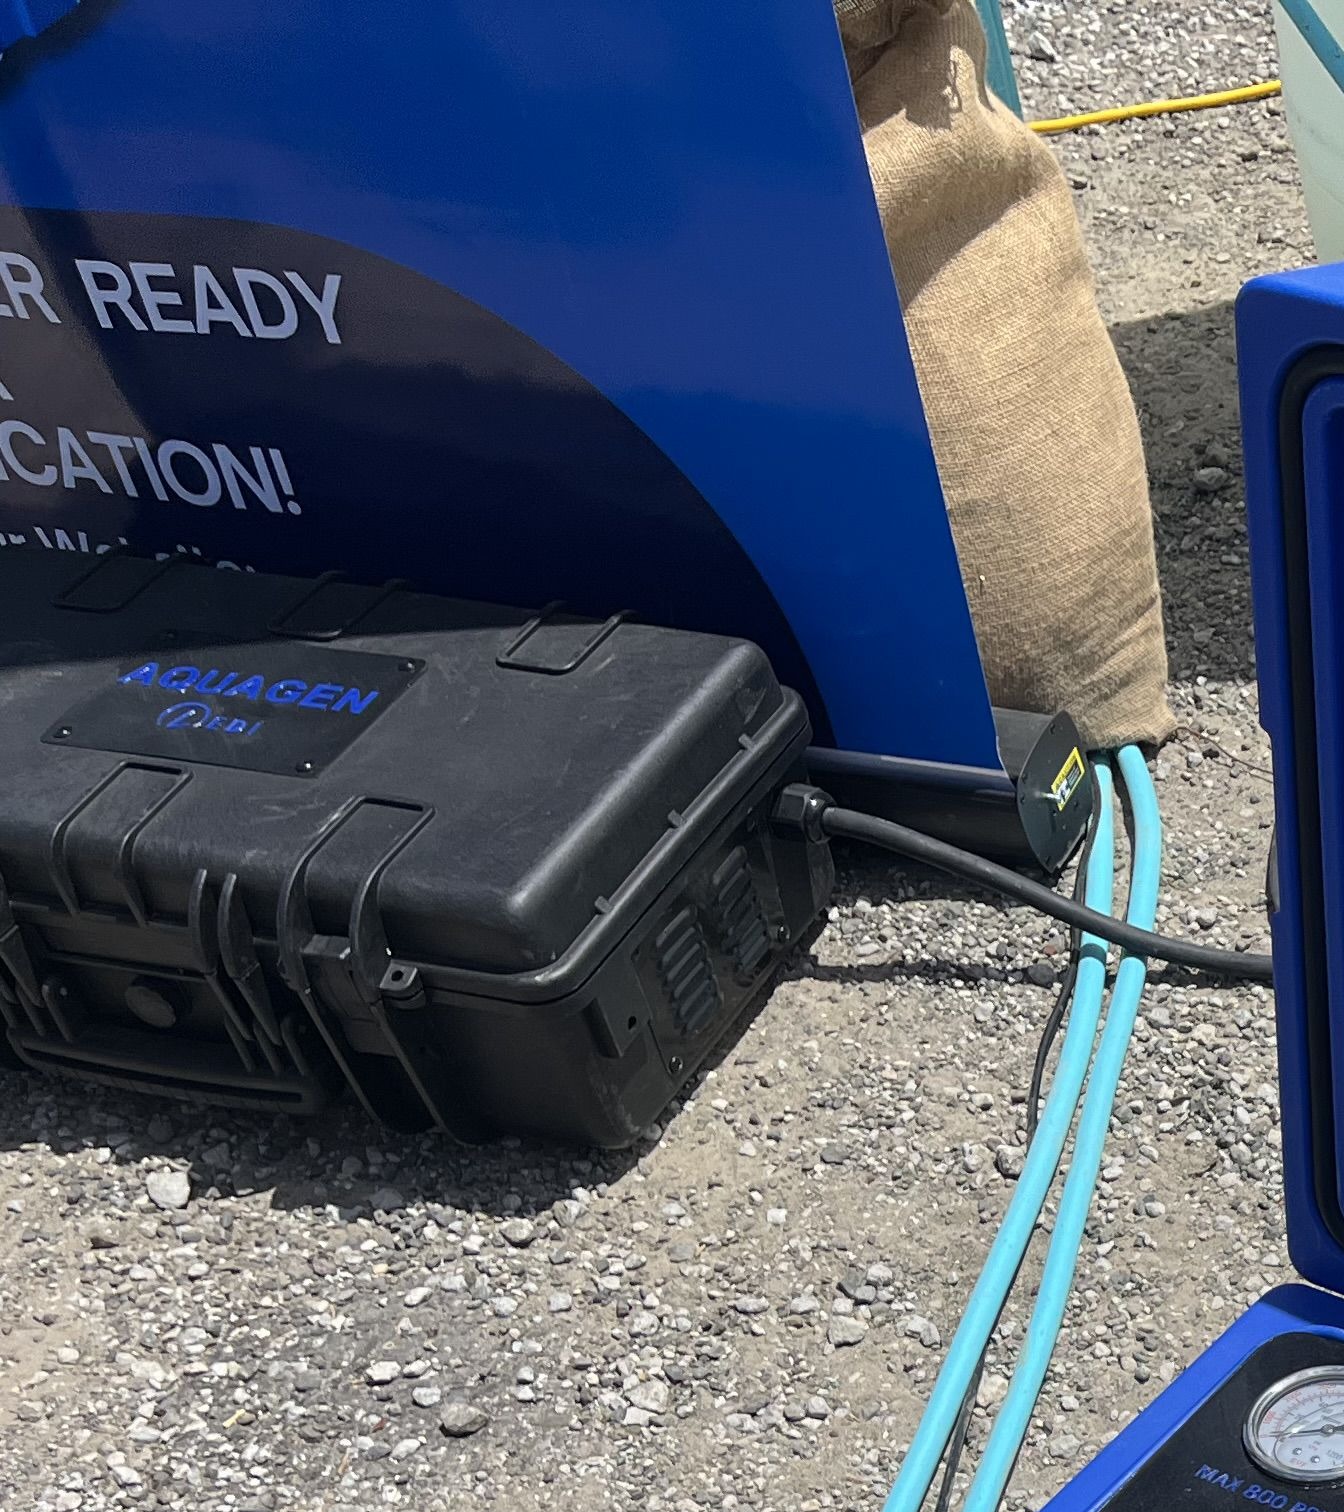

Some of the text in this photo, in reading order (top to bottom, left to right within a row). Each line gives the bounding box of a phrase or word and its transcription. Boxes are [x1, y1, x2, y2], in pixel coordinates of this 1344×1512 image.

[75, 259, 342, 344] READY
[0, 419, 301, 515] CATION!
[117, 661, 379, 715] AQUAGEN
[1194, 1464, 1243, 1493] MAX
[1243, 1484, 1288, 1509] 800
